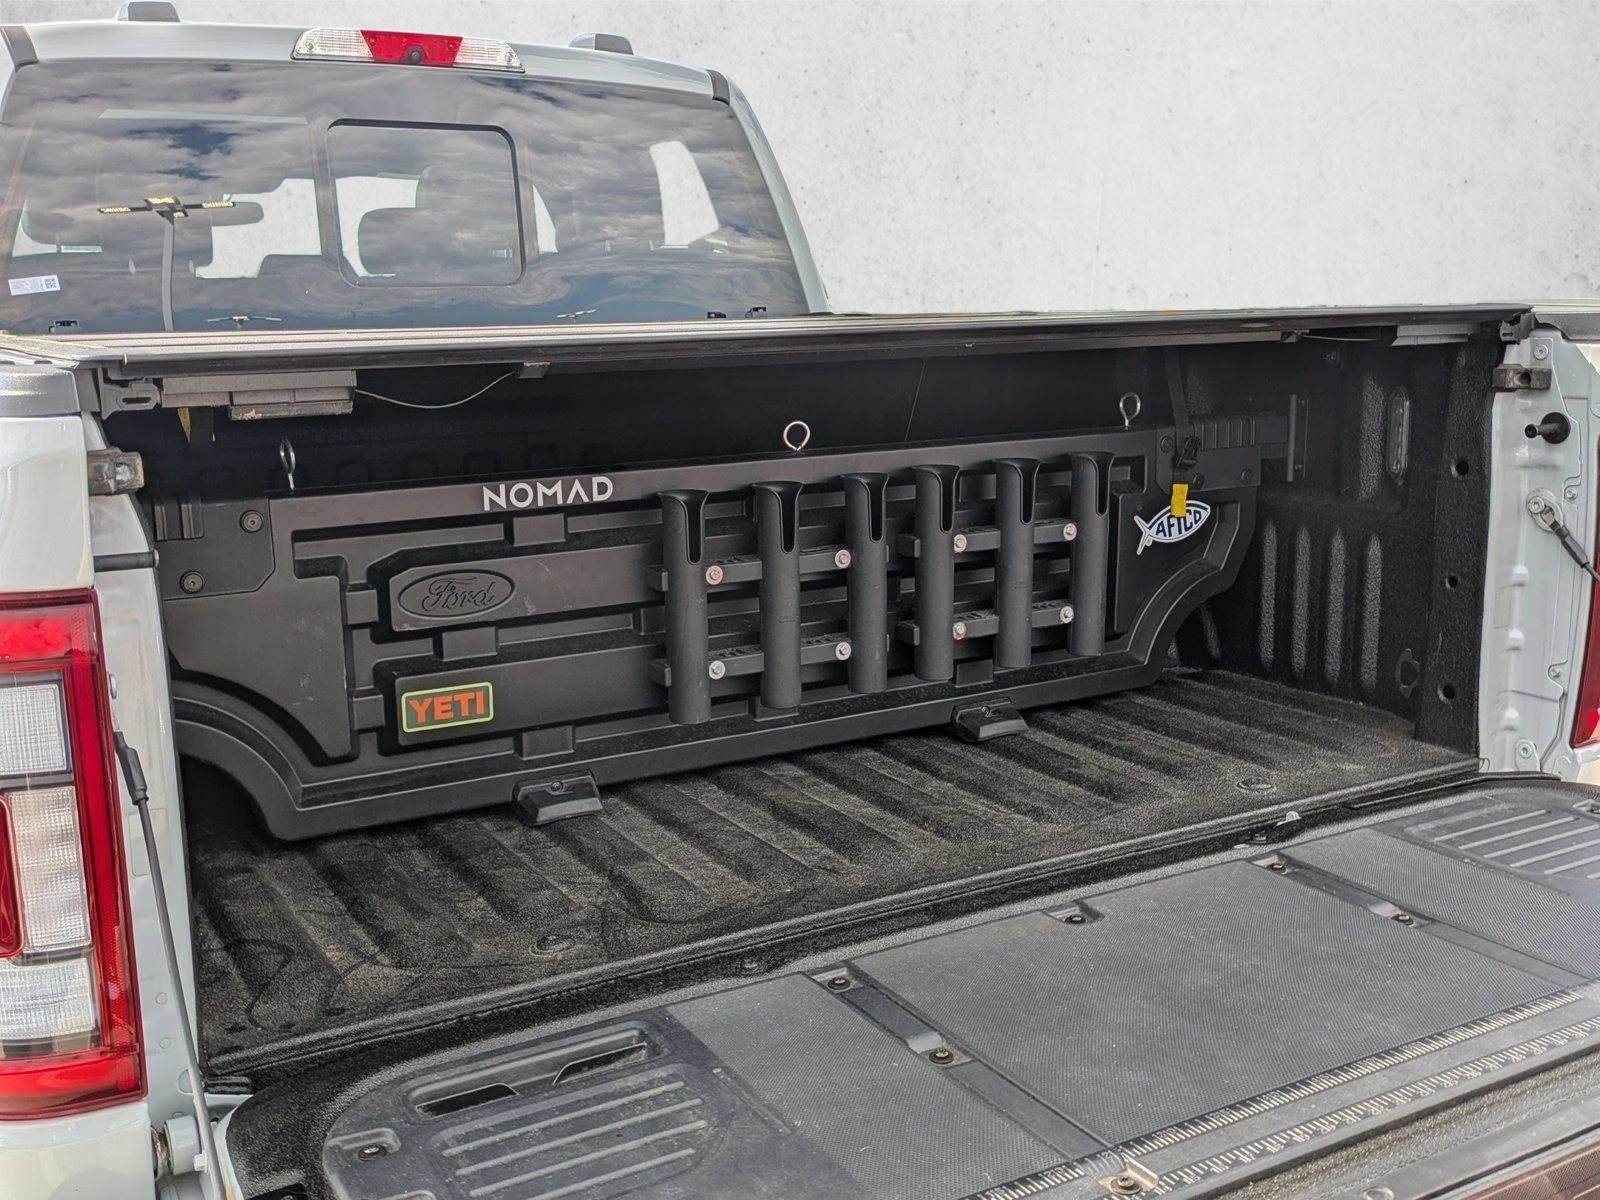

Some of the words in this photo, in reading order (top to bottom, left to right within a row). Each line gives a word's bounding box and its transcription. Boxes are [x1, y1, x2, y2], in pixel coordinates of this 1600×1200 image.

[483, 476, 613, 511] NOMAD
[421, 577, 498, 612] Ford
[409, 689, 485, 723] YETI
